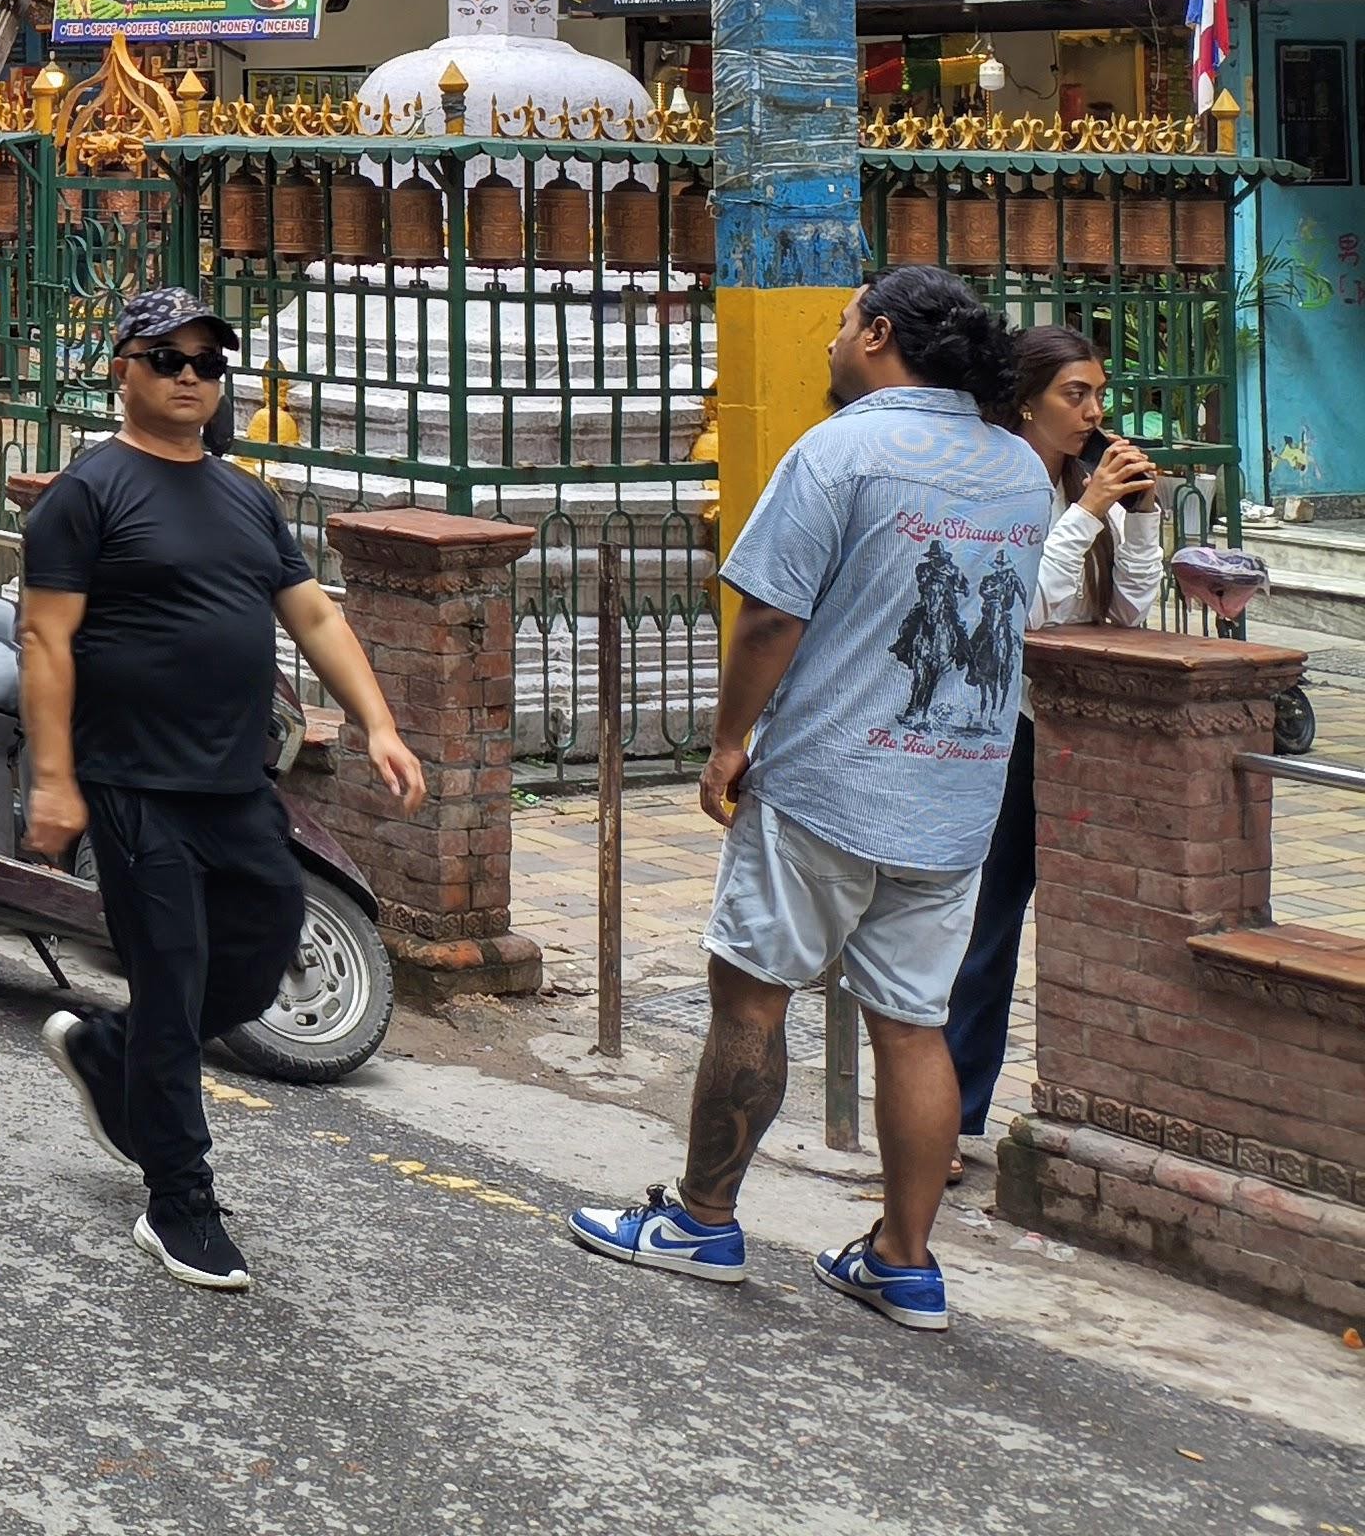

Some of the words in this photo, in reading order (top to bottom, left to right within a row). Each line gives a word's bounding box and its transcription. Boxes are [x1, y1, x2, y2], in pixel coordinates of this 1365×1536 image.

[65, 23, 84, 36] TEA
[90, 23, 116, 36] SPICE
[124, 21, 160, 36] COFFEE
[167, 19, 211, 34] SAFFRON
[218, 19, 254, 33] HONEY
[262, 18, 310, 33] INCENSE
[895, 511, 942, 543] Levi
[942, 517, 1007, 544] Strauss
[1008, 524, 1024, 548] &
[867, 727, 899, 750] The
[903, 733, 935, 756] Two
[936, 739, 979, 761] Horse
